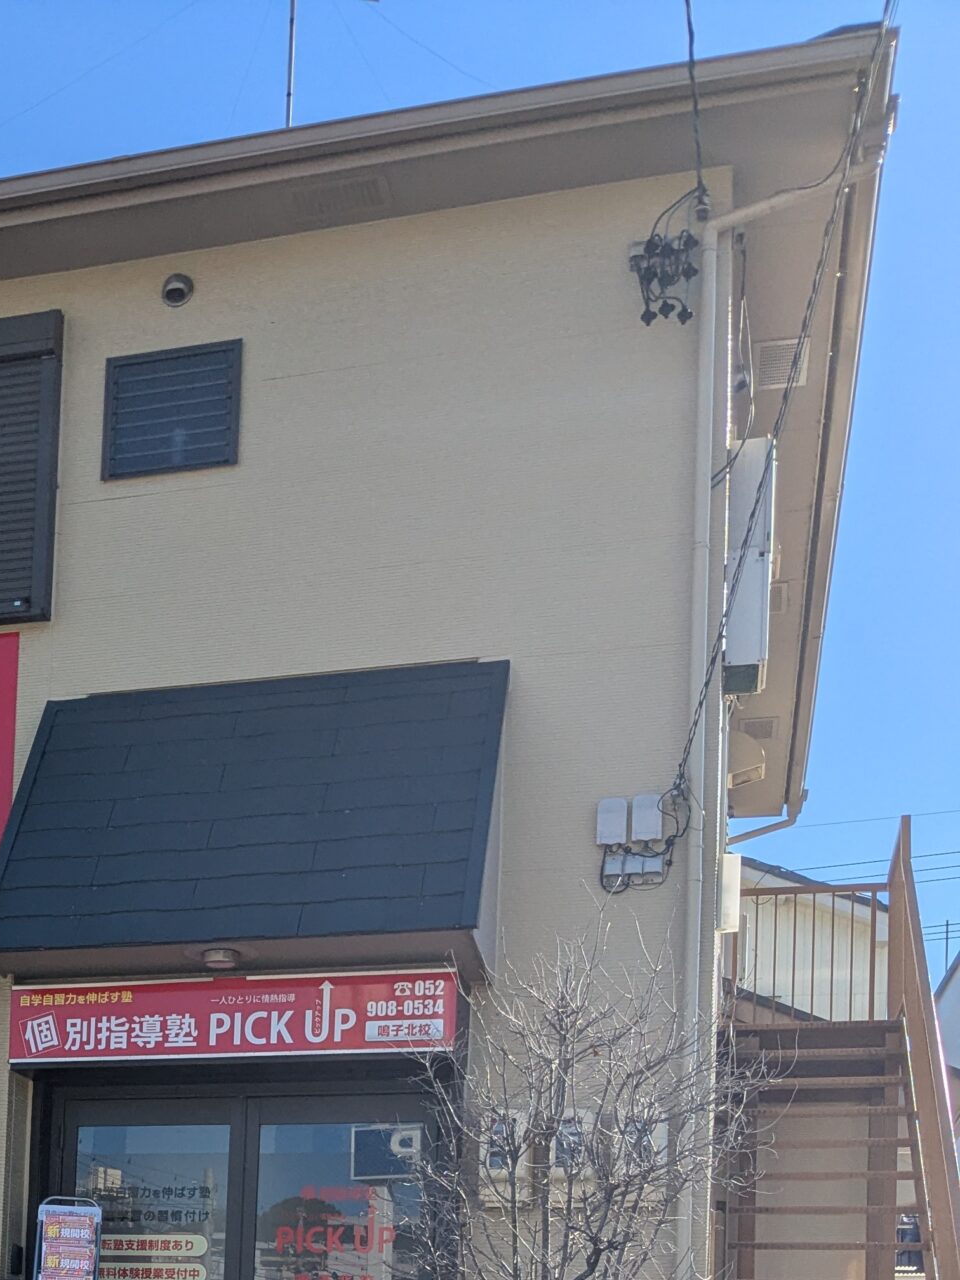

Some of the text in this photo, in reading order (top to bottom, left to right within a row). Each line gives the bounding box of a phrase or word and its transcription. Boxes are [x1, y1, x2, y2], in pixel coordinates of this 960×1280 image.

[414, 980, 445, 996] 052
[19, 991, 133, 1006] 自学自習力を伸ばす塾
[210, 993, 296, 1005] 一人ひとりに情熱指導
[208, 980, 357, 1046] PICK UP
[366, 999, 445, 1017] 908-0534
[24, 1013, 198, 1054] 個別指導塾
[377, 1023, 432, 1037] 鳴子北校
[275, 1205, 396, 1255] PICK UP
[101, 1239, 194, 1251] 転塾支援制度あり
